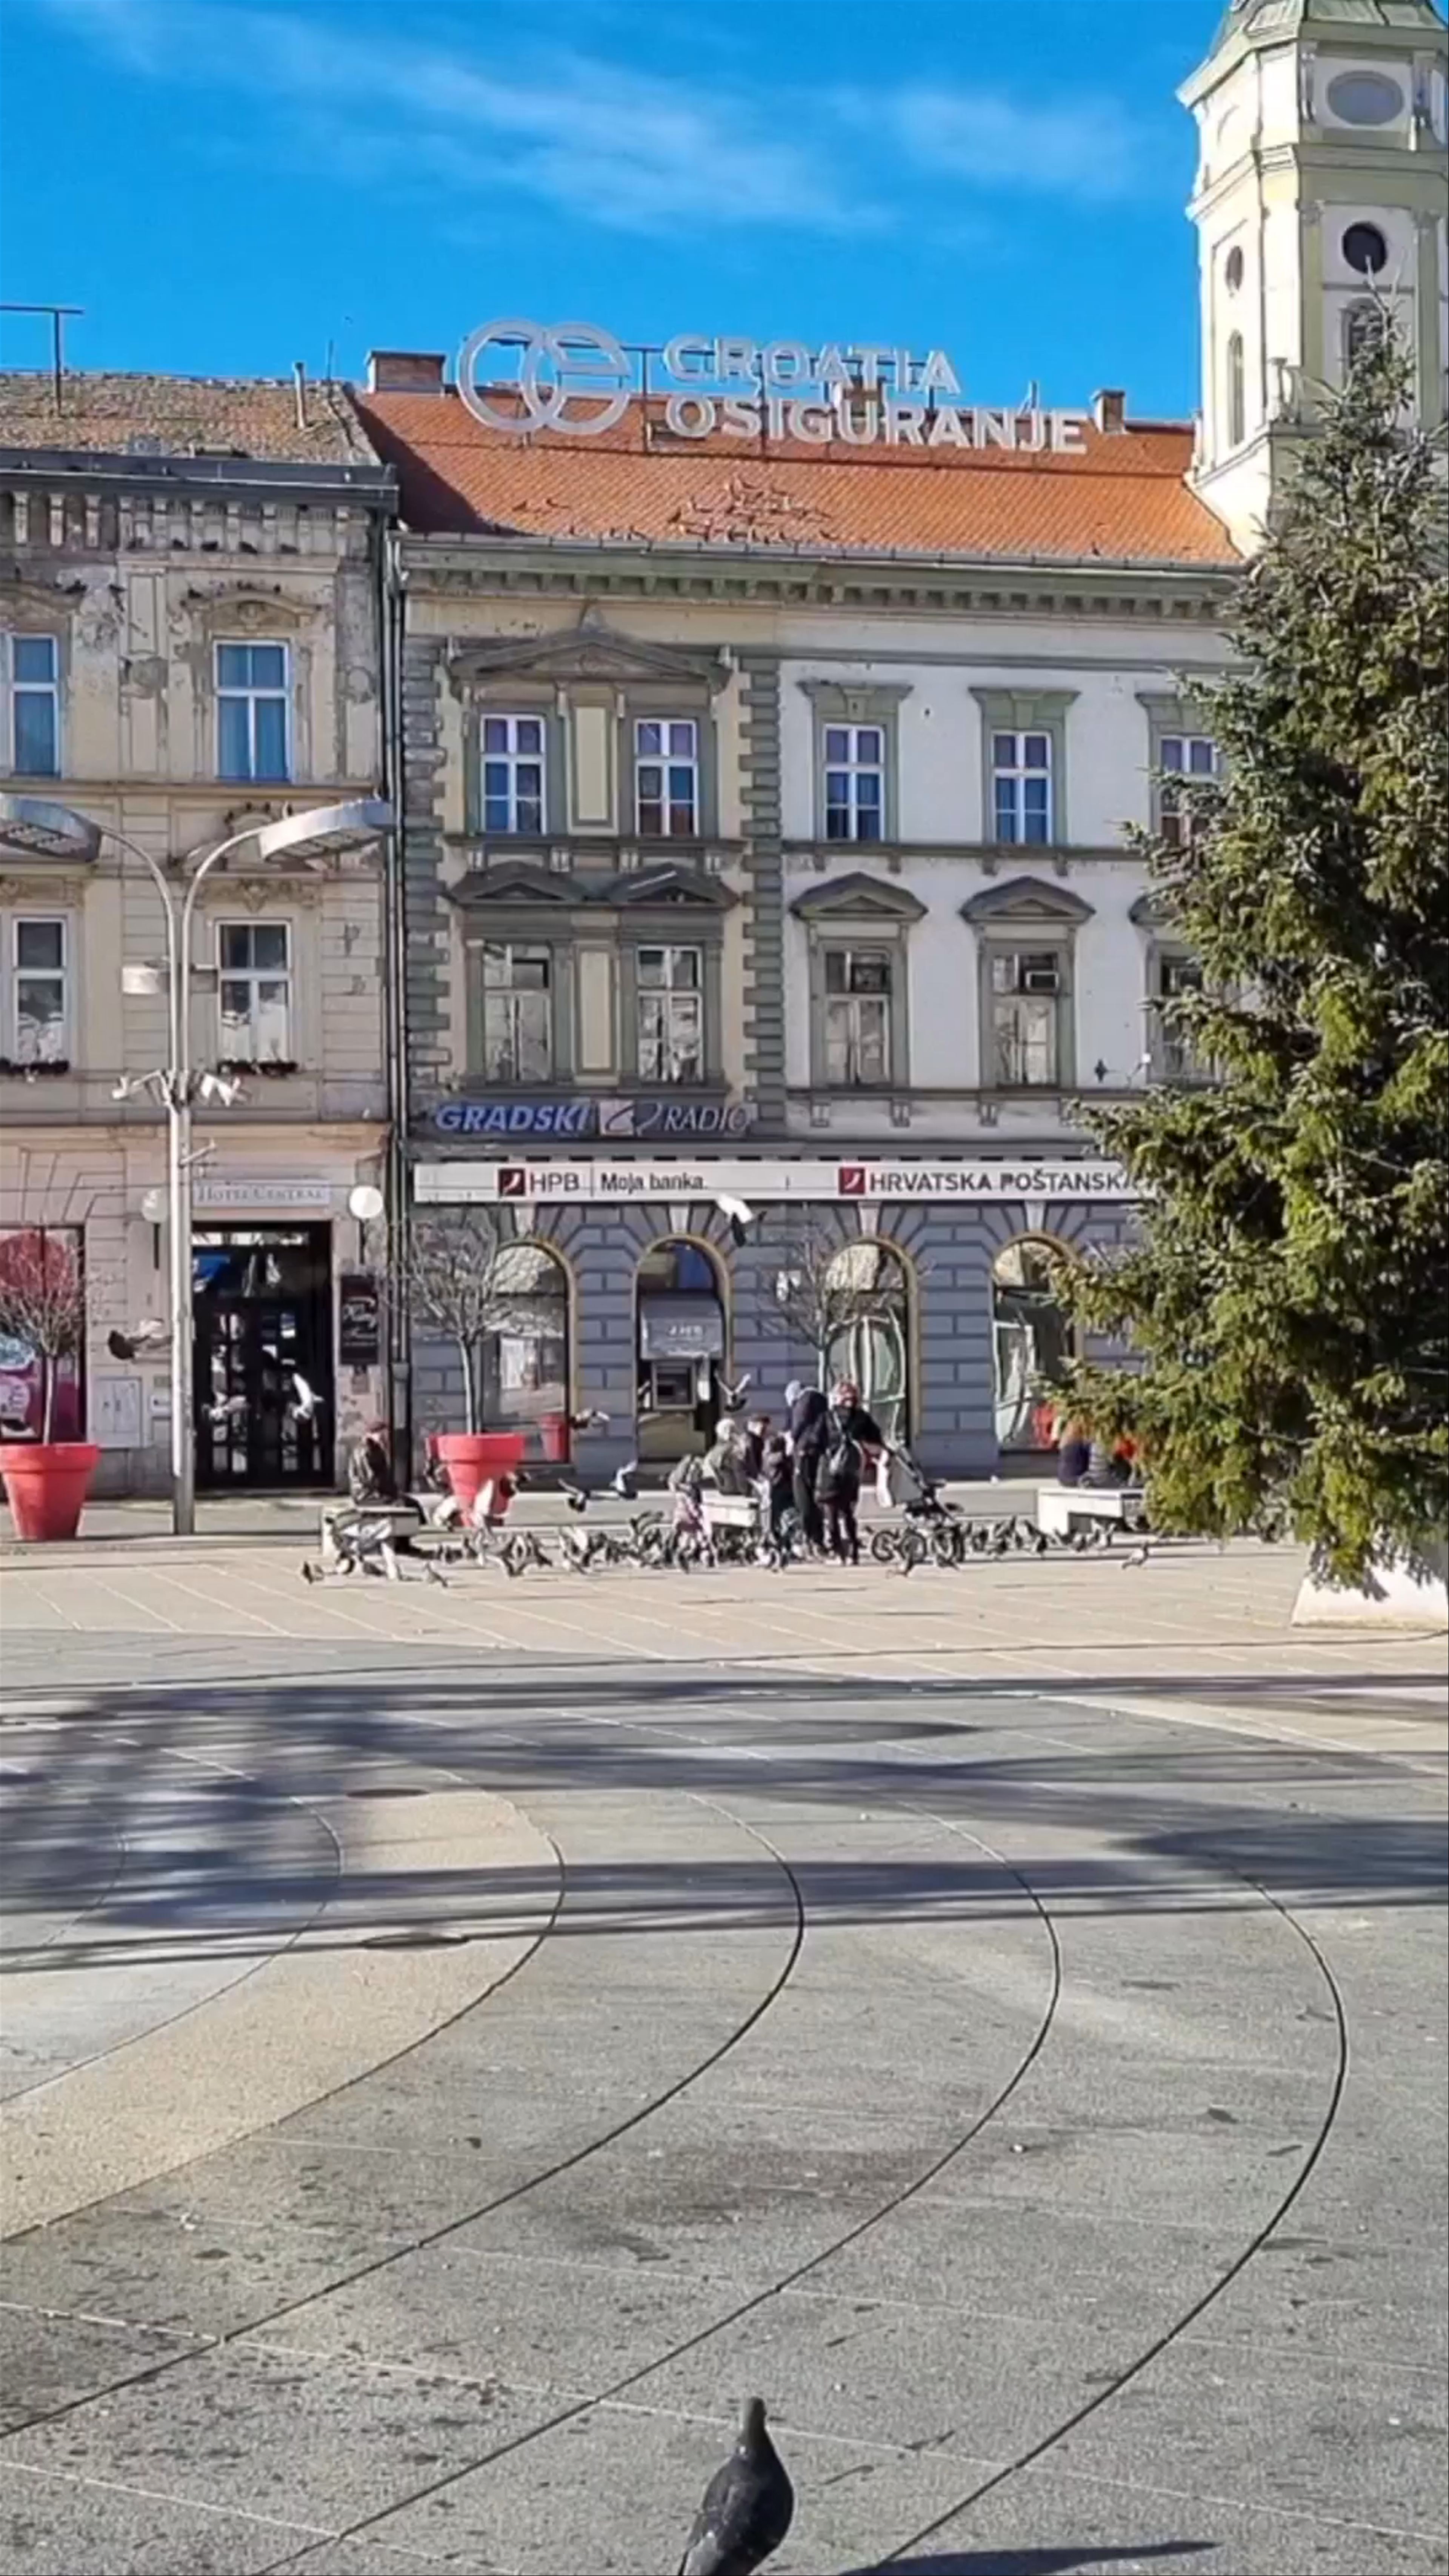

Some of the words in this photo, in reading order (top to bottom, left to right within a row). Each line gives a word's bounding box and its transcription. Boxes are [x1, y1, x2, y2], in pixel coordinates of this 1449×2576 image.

[664, 334, 961, 394] CROATIA
[666, 395, 1087, 454] OSIGURANJE
[436, 1105, 589, 1131] GRADSKI
[663, 1105, 751, 1131] RADIO
[530, 1172, 580, 1192] HPB
[601, 1172, 644, 1194] Moja
[869, 1172, 992, 1192] HRVATSKA
